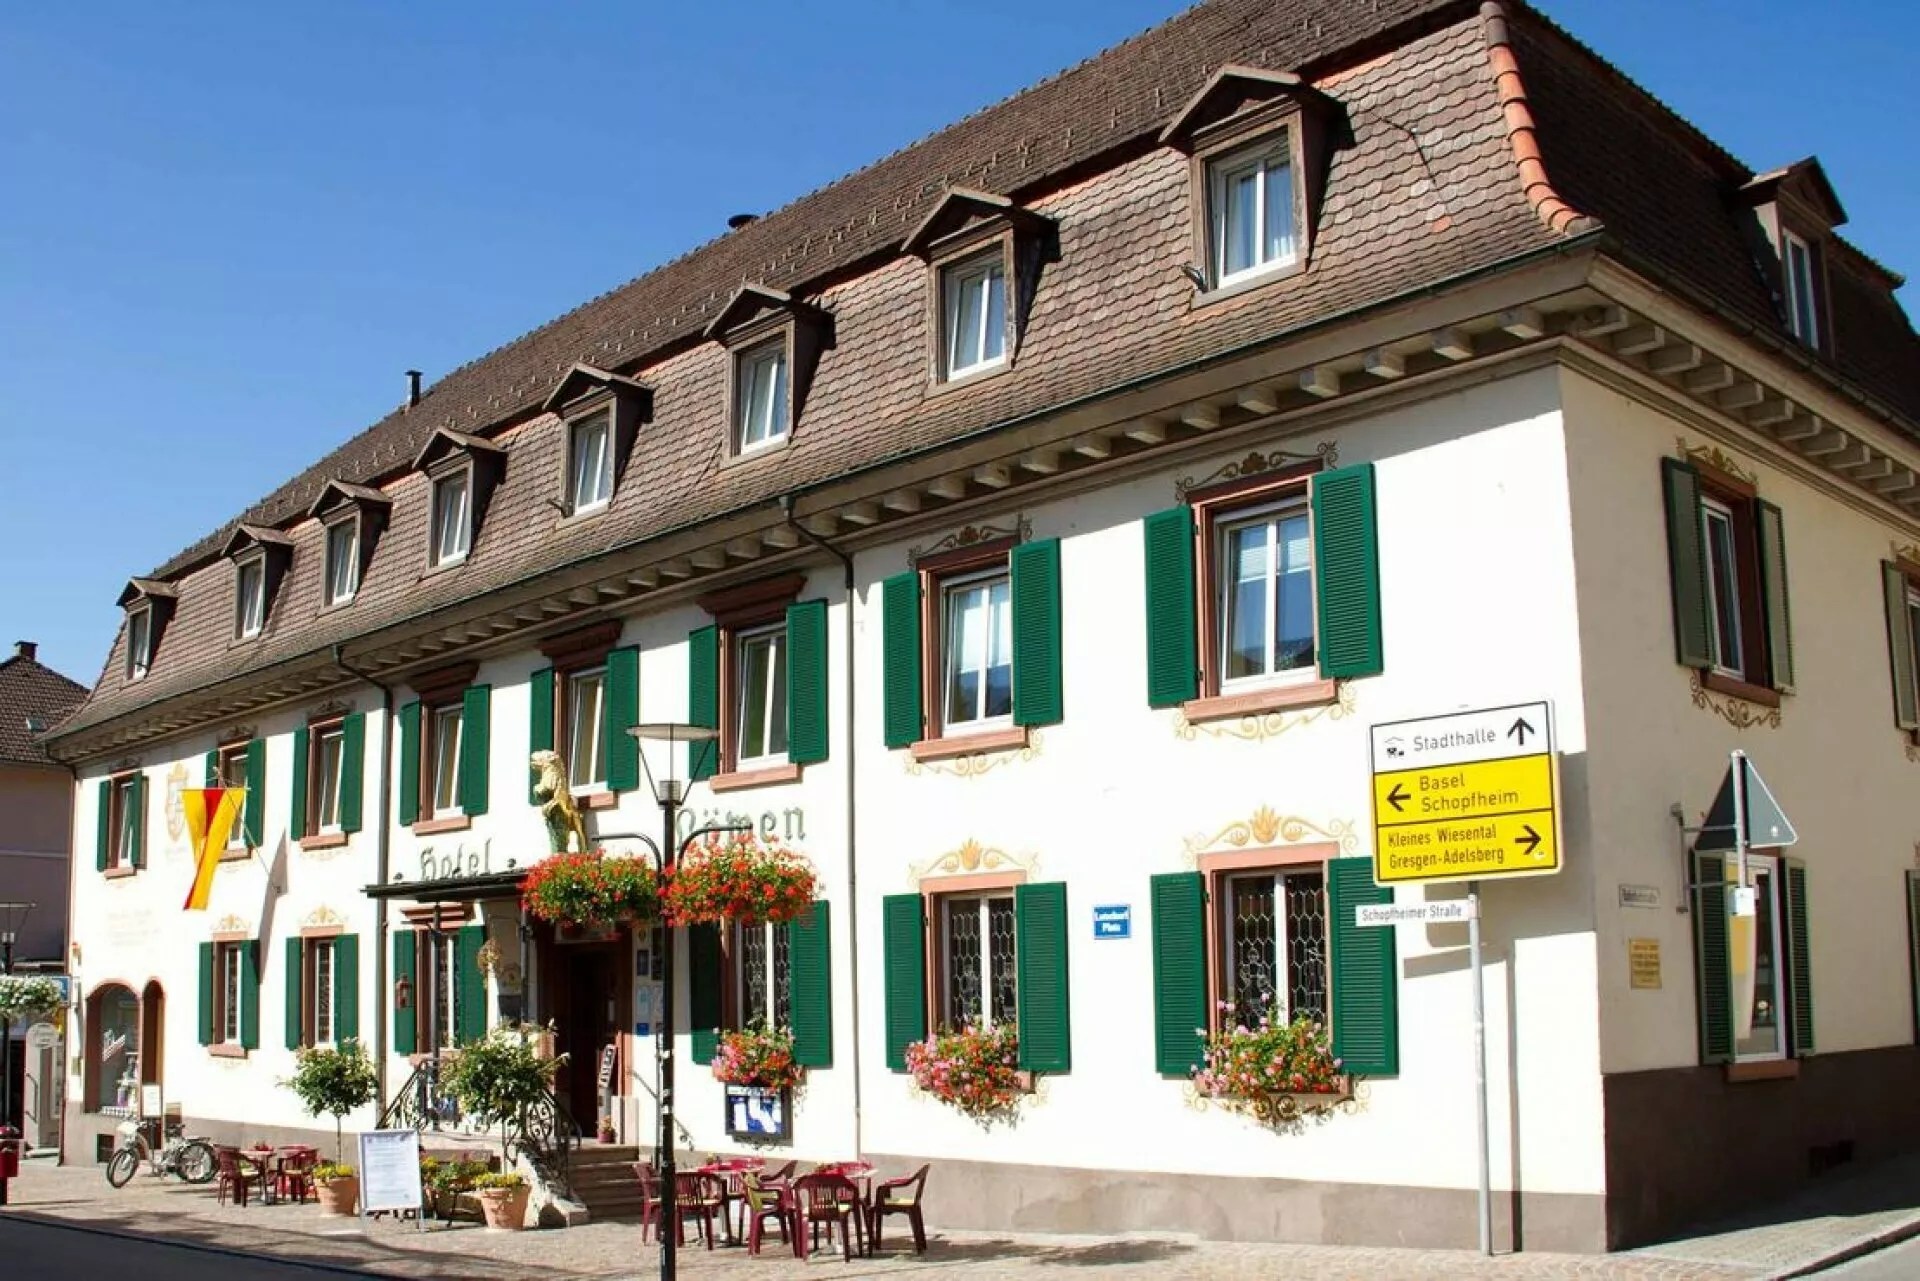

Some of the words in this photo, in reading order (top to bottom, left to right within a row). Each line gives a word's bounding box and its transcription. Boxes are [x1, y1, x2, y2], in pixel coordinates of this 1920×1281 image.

[1413, 729, 1496, 752] Stadthalle
[1419, 772, 1465, 791] Basel
[1421, 791, 1519, 812] Schopfheim
[1388, 831, 1431, 848] Kleines
[1437, 823, 1497, 843] Wiesental
[420, 837, 492, 880] Hotel
[1390, 847, 1504, 871] Gresgen-Adelsberg
[1362, 908, 1427, 922] Schopfheimer
[1430, 904, 1462, 917] Straße
